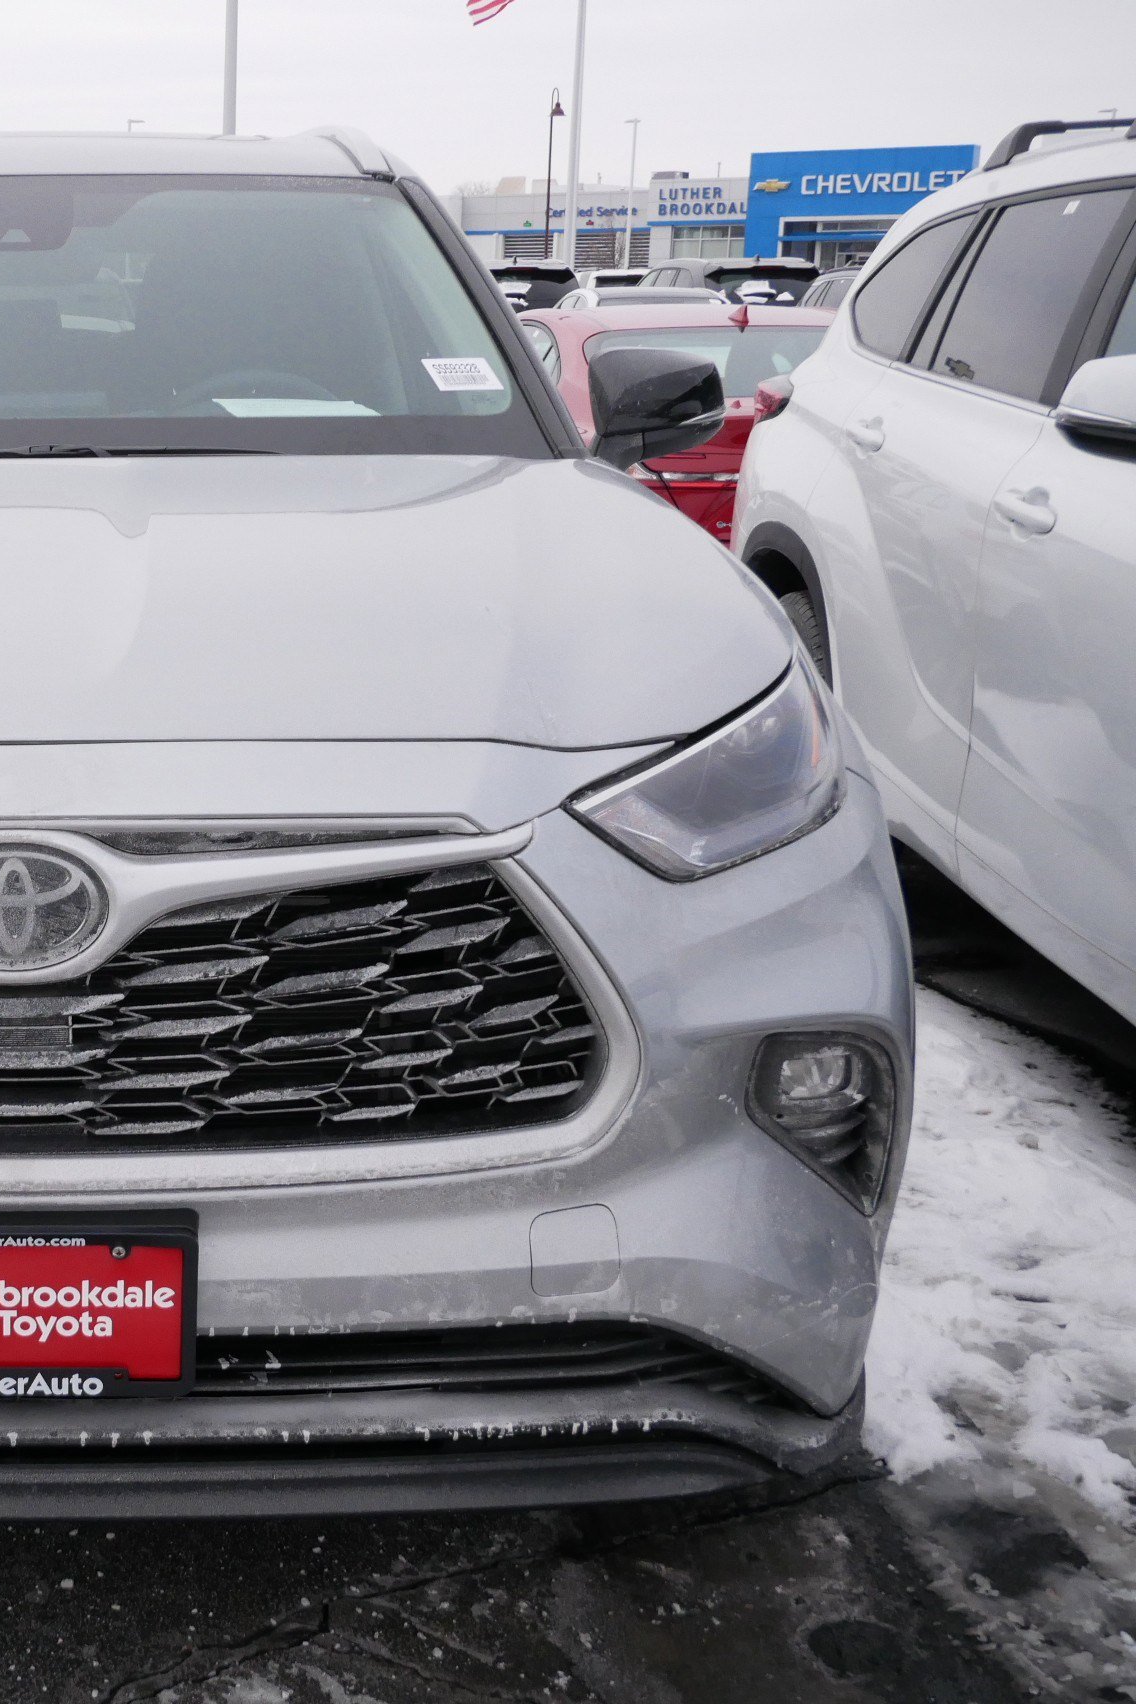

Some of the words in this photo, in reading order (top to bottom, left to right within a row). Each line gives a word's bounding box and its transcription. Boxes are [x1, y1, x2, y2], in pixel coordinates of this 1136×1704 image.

[800, 170, 966, 196] CHEVROLET
[659, 187, 723, 201] LUTHER
[547, 206, 594, 218] Ceried
[658, 202, 748, 216] BROOKDAL
